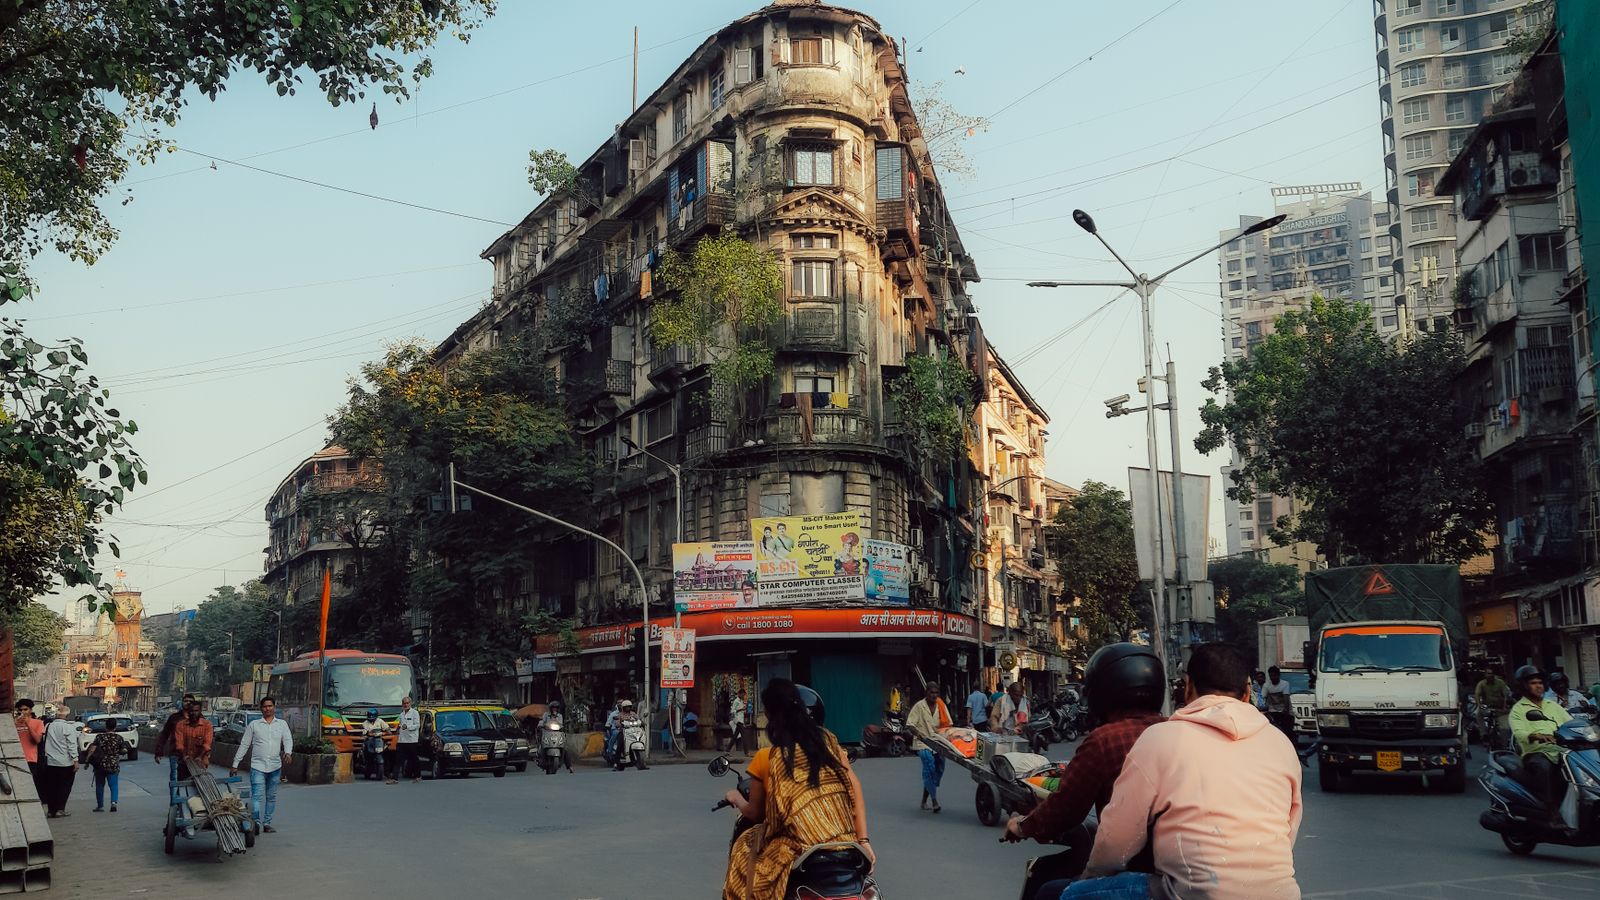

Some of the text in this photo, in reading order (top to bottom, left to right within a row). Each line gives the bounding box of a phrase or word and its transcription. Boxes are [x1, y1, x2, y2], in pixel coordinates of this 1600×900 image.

[1280, 214, 1346, 231] CHANDAN HEIGHTS
[759, 560, 796, 574] MS-CIT
[760, 576, 861, 590] STAR COMPUTER CLASSES
[947, 617, 964, 632] ICICI
